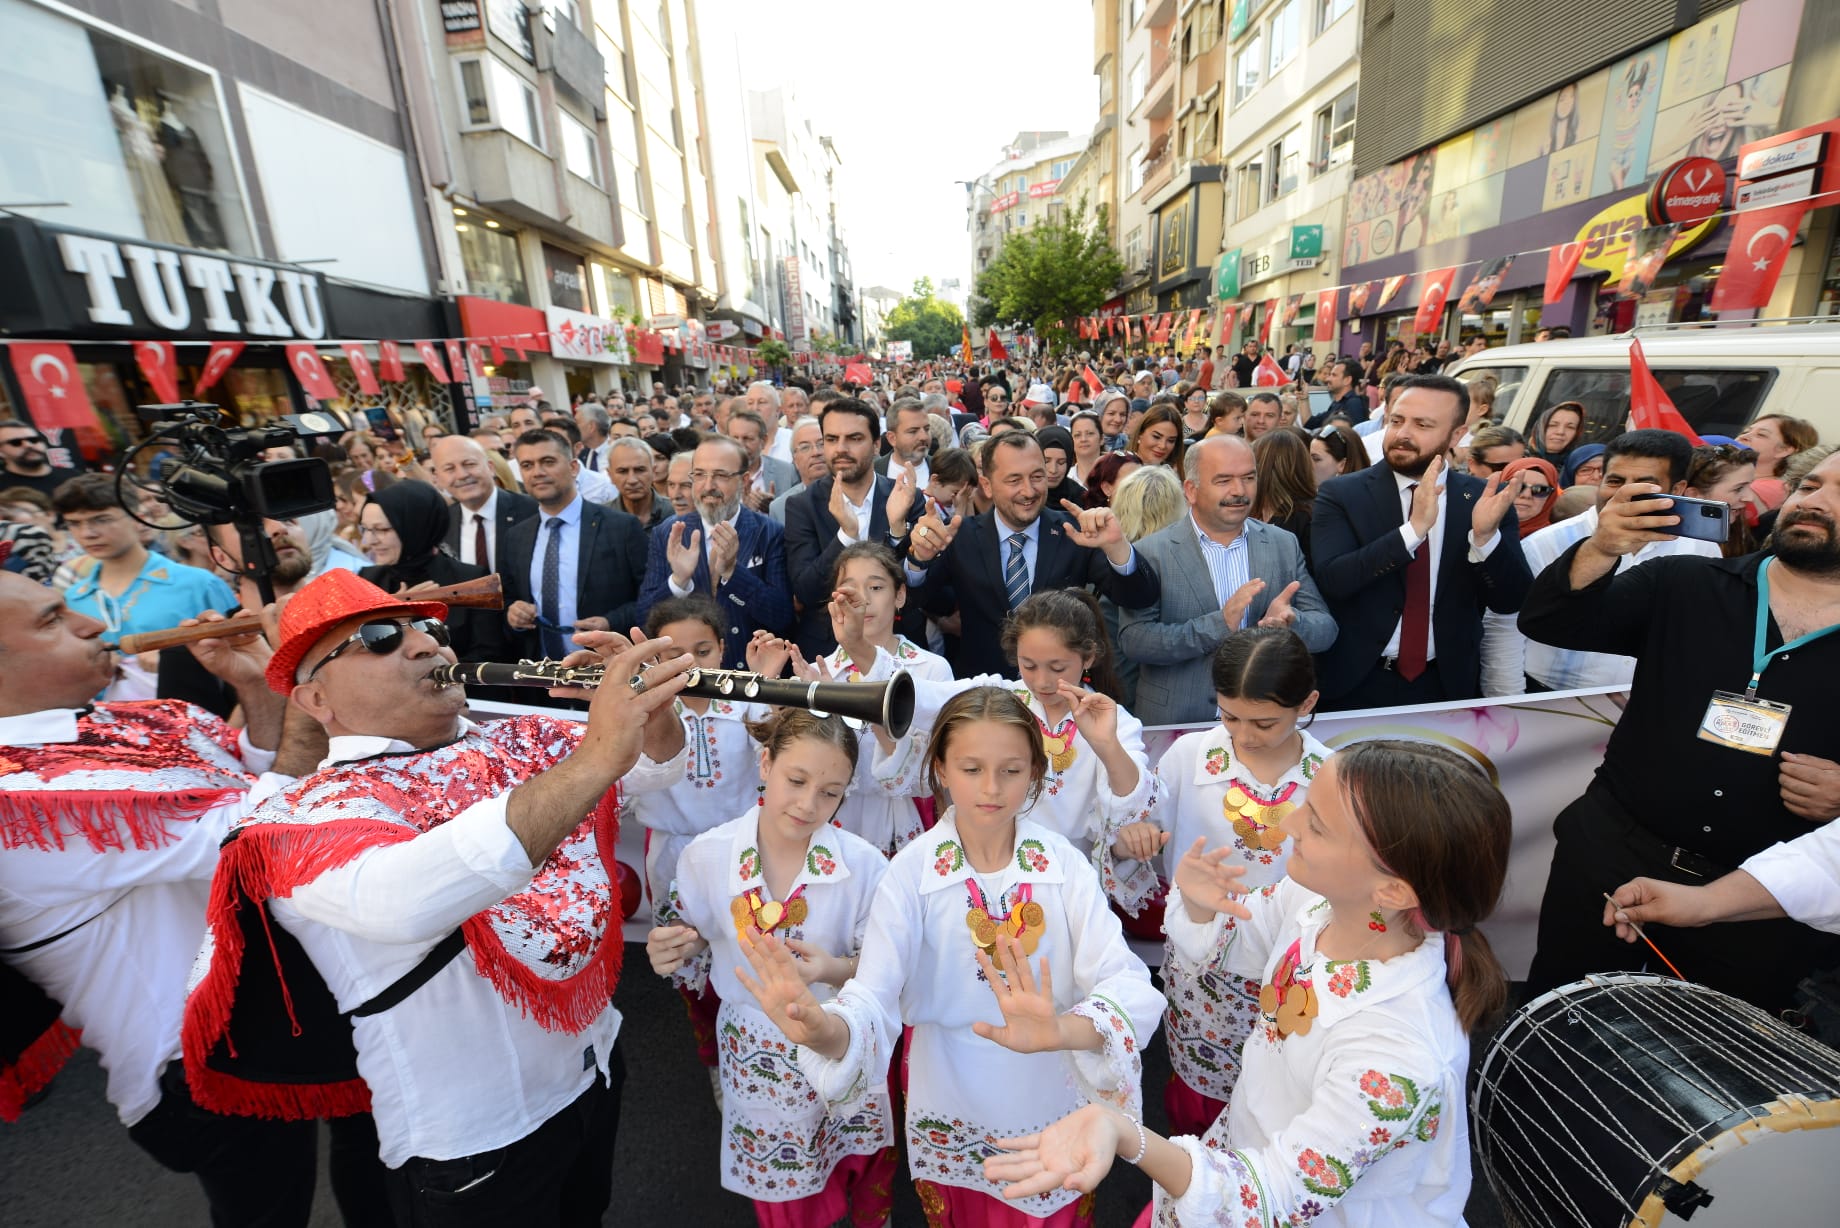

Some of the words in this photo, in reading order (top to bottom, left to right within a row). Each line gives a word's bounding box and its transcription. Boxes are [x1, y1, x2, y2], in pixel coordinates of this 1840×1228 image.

[1666, 192, 1721, 208] elmasgrafik
[1249, 255, 1271, 277] TEB
[1295, 259, 1312, 268] TEB
[56, 233, 326, 340] TUTKU
